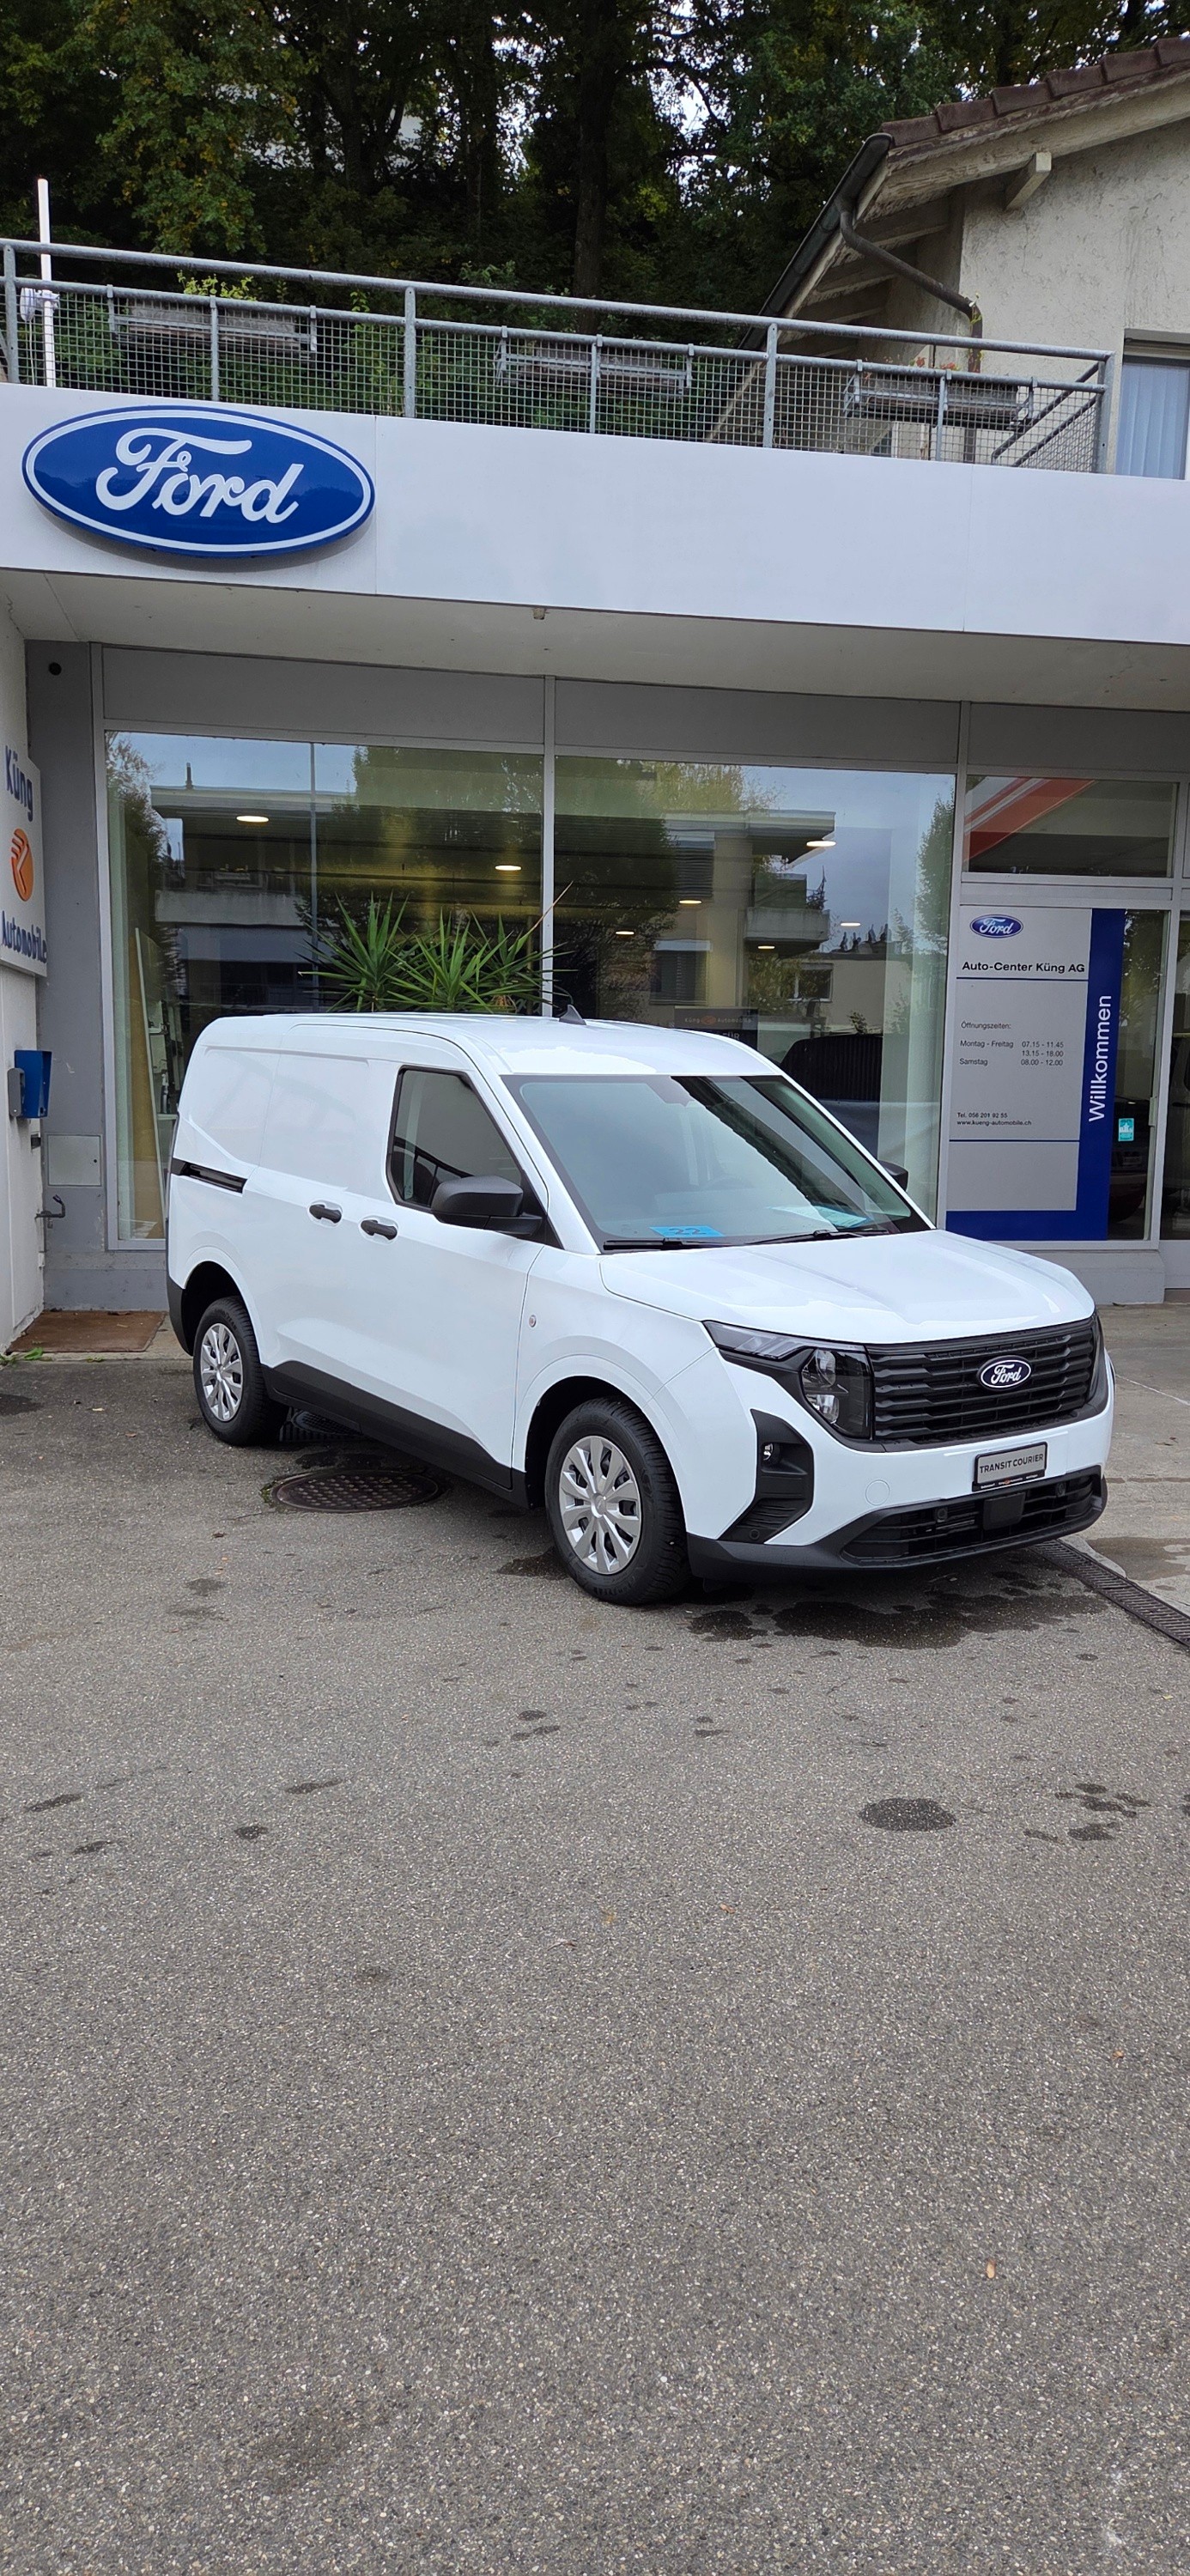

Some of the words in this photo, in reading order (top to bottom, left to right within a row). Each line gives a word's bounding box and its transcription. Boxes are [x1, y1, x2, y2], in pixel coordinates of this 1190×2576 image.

[95, 428, 304, 524] Ford
[5, 744, 33, 822] Küng
[979, 917, 1015, 935] Ford
[2, 909, 47, 964] Automobile
[962, 961, 1033, 972] Auto-Center
[1035, 963, 1066, 974] Küng
[1068, 963, 1085, 973] AG
[961, 1021, 1012, 1030] Öffnungszeiten:
[960, 1040, 986, 1048] Montag
[991, 1040, 1014, 1048] Freitag
[959, 1058, 988, 1066] Samstag
[1088, 995, 1112, 1122] Willkommen
[990, 1364, 1023, 1384] Ford
[979, 1460, 1012, 1473] TRANSIT
[1012, 1453, 1044, 1467] COURIER
